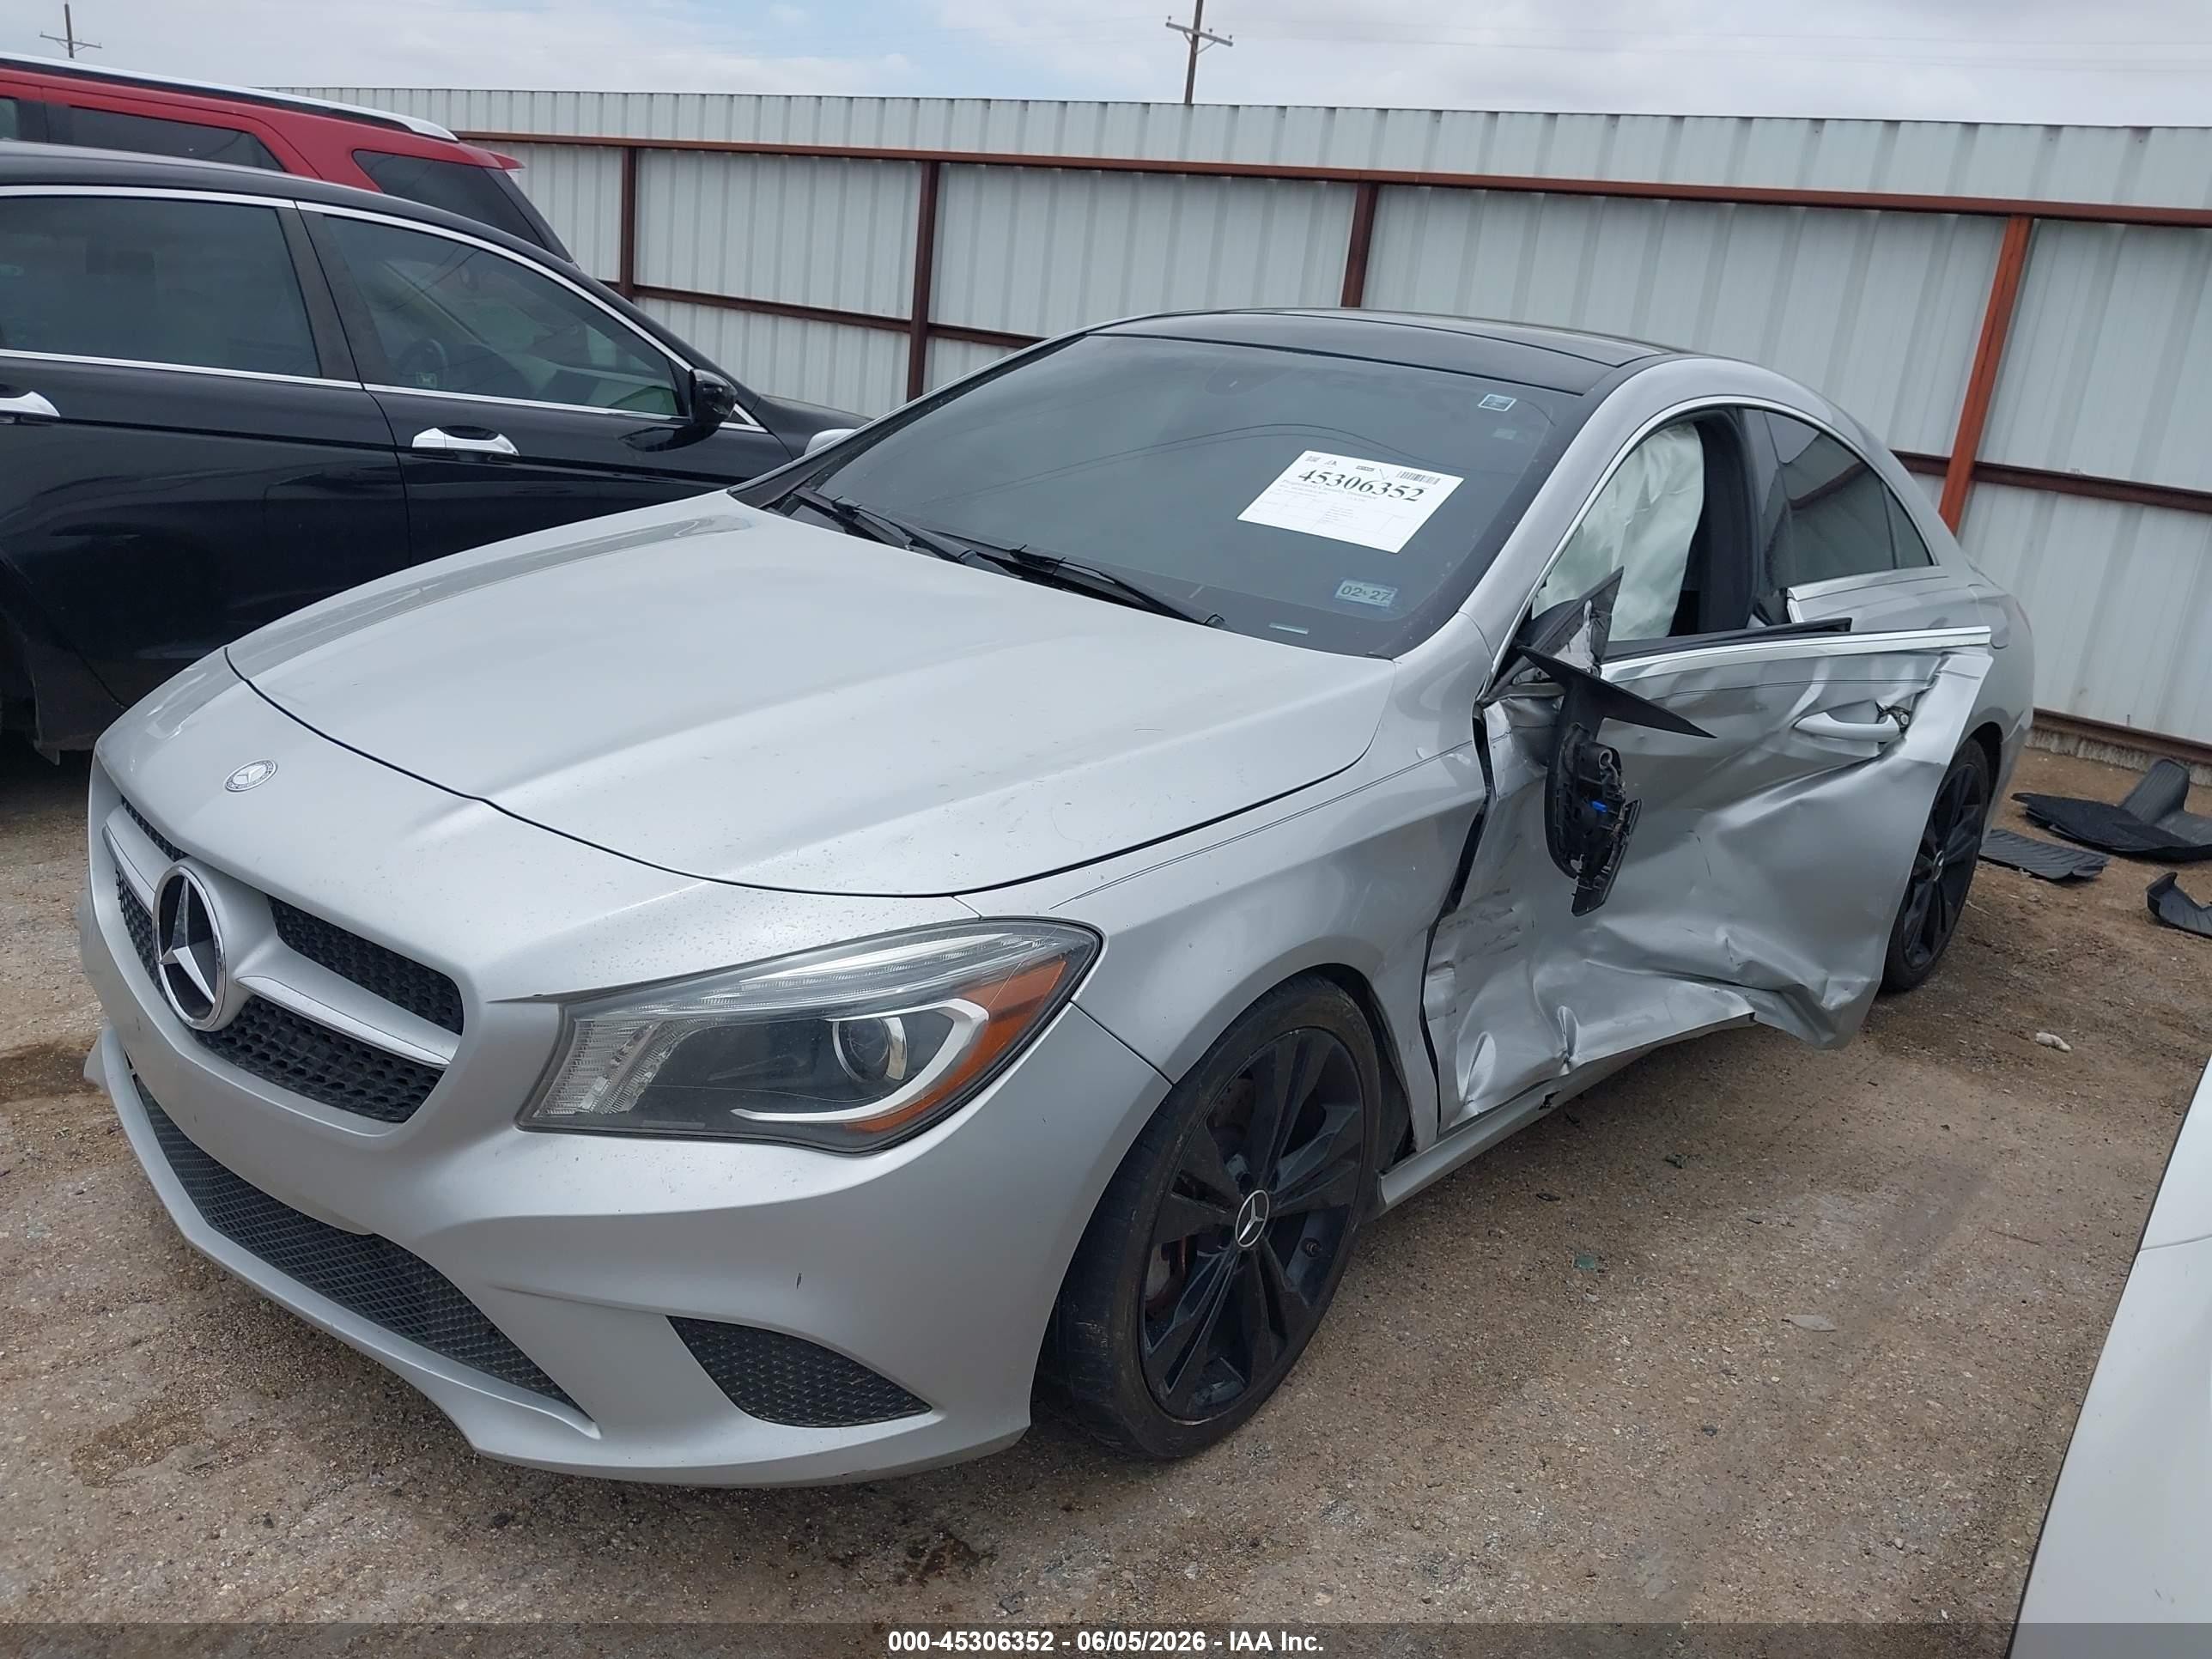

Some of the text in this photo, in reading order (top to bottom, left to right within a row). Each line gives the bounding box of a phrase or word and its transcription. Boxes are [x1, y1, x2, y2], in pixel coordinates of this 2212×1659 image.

[1297, 469, 1425, 501] 45306352
[1341, 586, 1391, 601] 02 27
